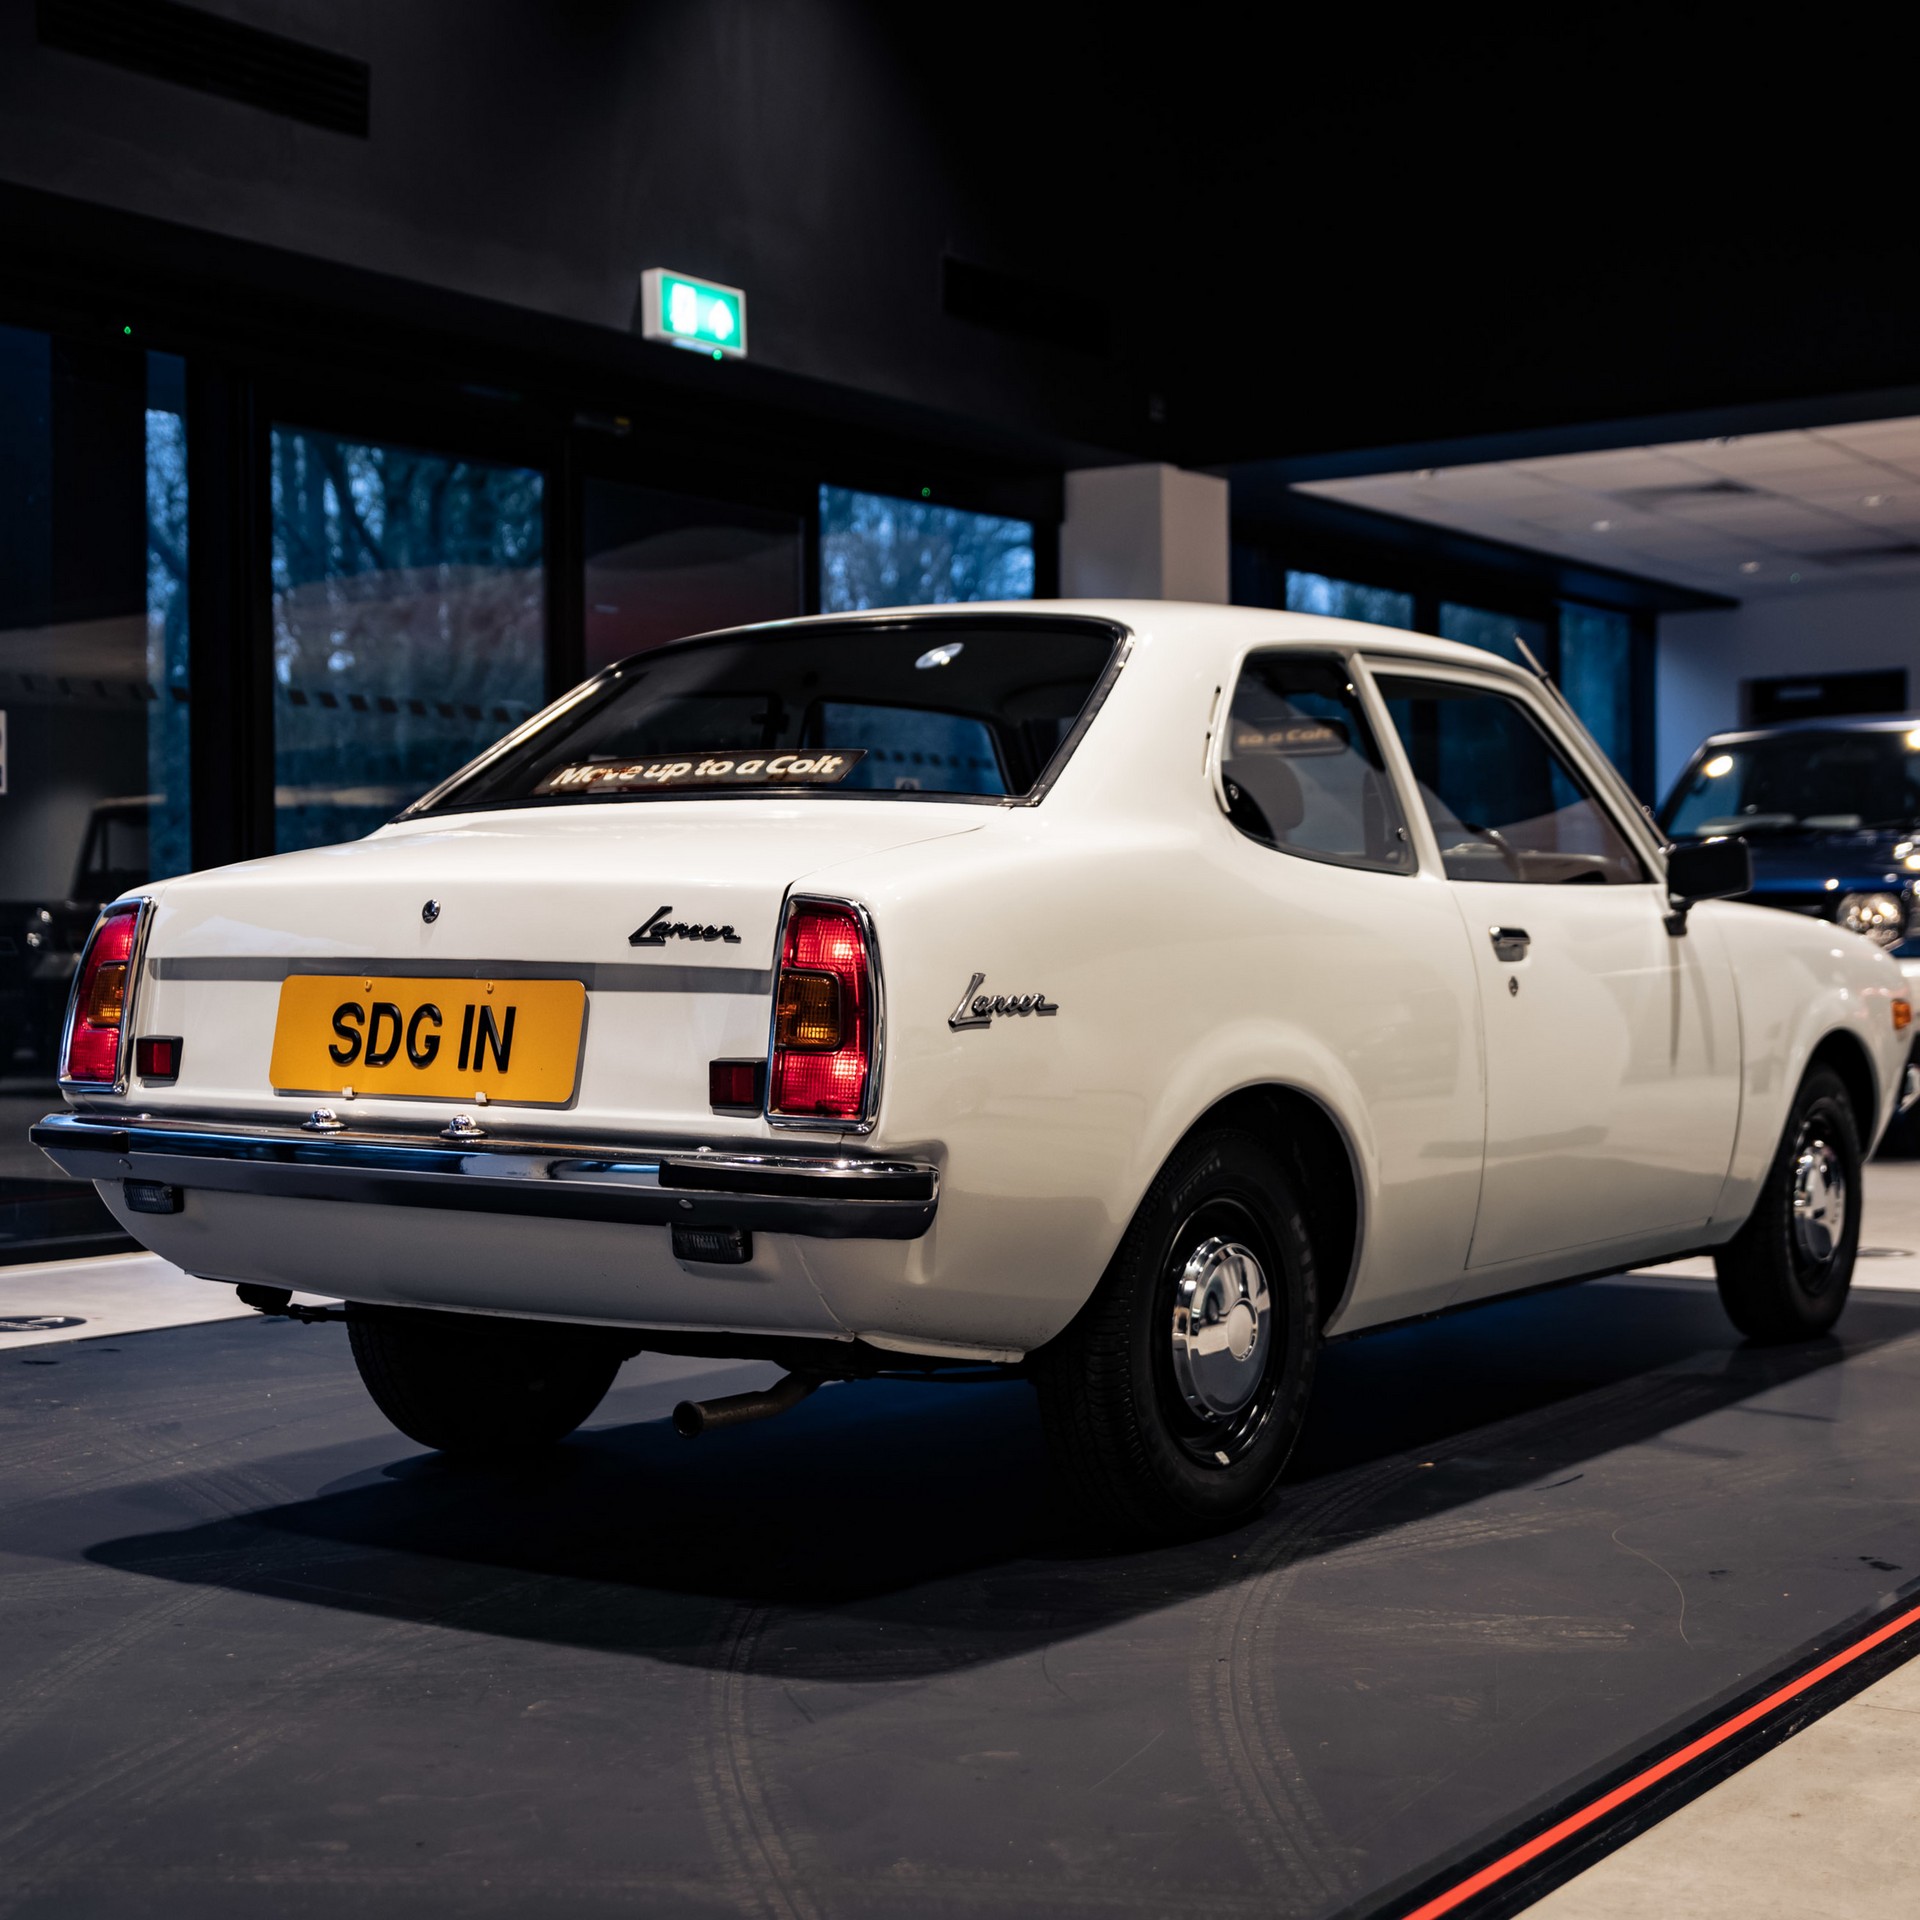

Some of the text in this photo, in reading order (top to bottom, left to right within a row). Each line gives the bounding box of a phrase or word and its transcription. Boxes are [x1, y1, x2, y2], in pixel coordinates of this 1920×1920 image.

[549, 755, 843, 786] Move up to a Colt
[628, 905, 742, 947] Lancer
[947, 972, 1059, 1033] Lancer
[328, 1001, 443, 1069] SDG
